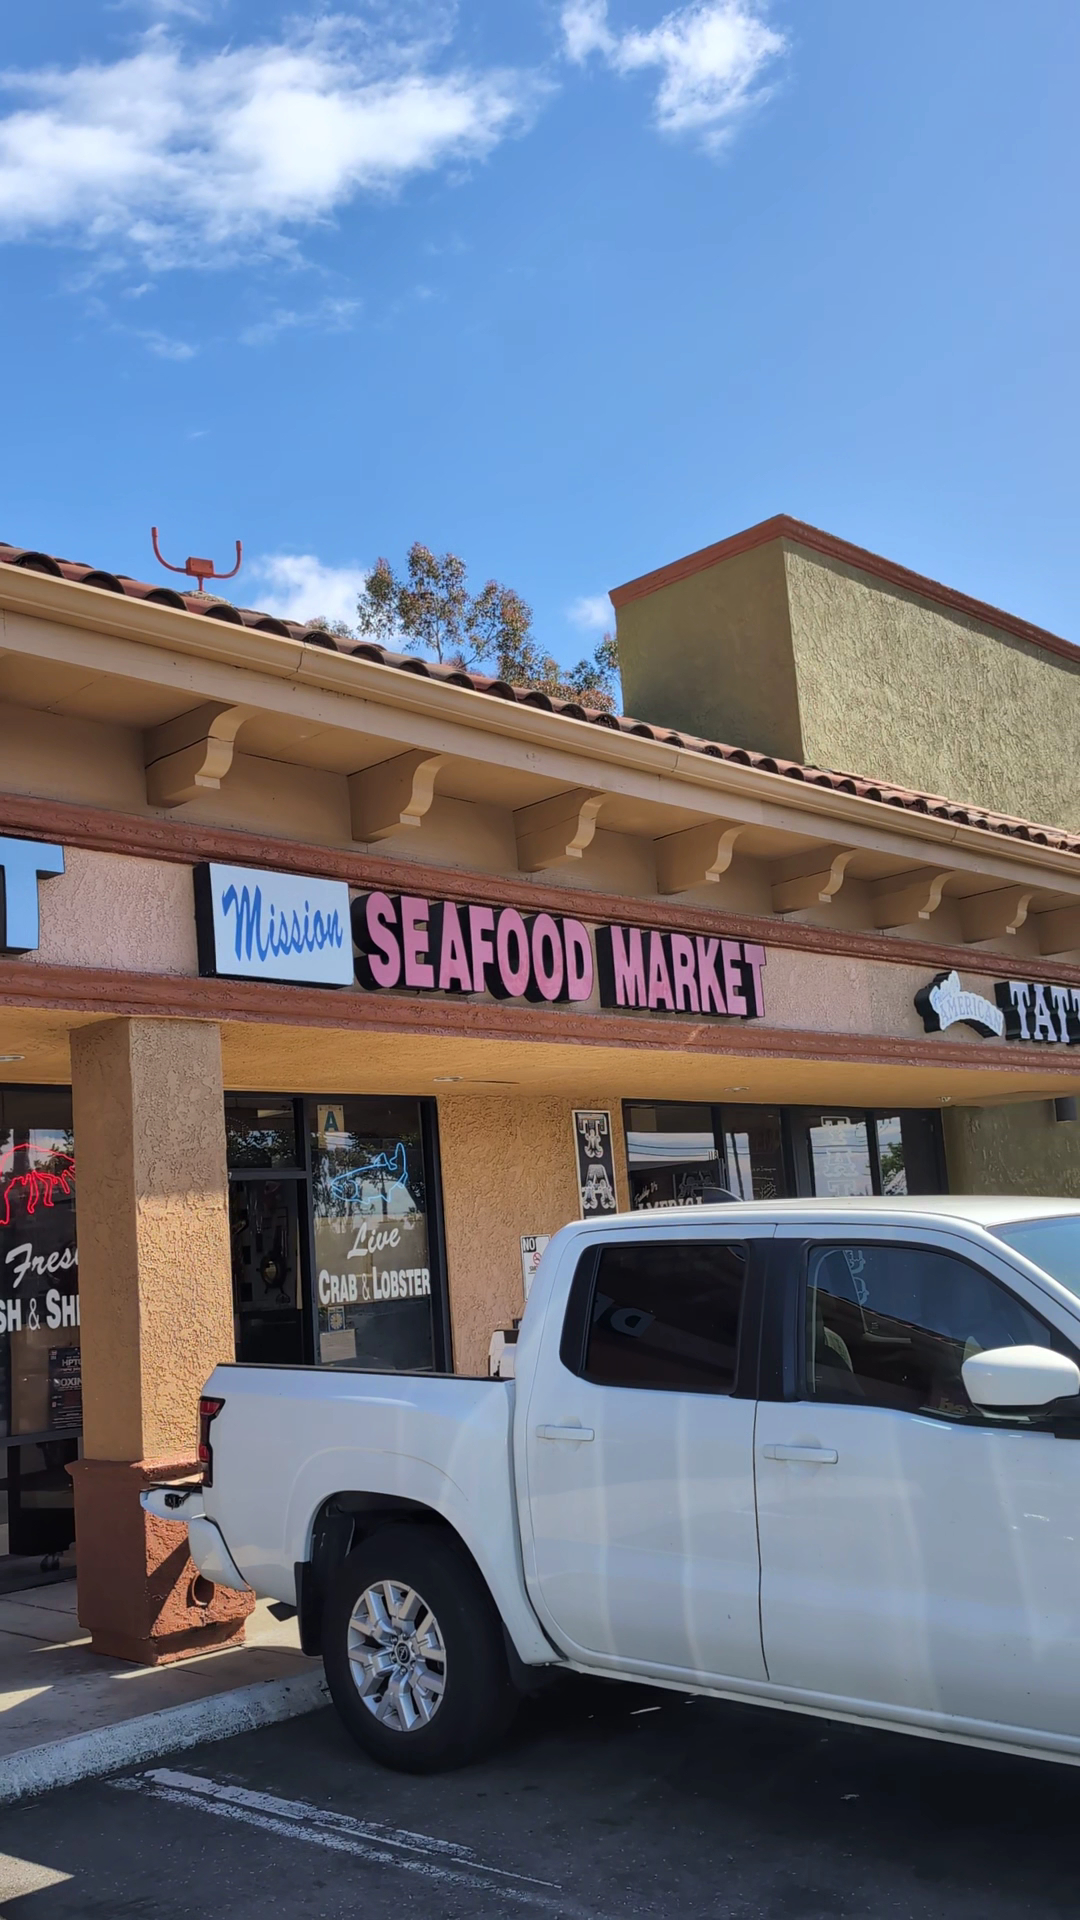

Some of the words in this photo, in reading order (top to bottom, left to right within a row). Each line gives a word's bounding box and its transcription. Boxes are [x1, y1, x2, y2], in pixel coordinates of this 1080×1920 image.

[0, 836, 65, 950] T
[222, 883, 343, 962] Mission
[366, 892, 593, 1000] SEAFOOD
[610, 925, 767, 1018] MARKET
[939, 996, 1002, 1030] AMERICAN
[324, 1111, 339, 1131] A
[577, 1113, 616, 1219] TA
[347, 1222, 400, 1259] Live
[522, 1237, 535, 1251] NO
[319, 1269, 357, 1304] CRAB
[361, 1278, 371, 1300] &
[372, 1266, 431, 1299] LOBSTER
[28, 1298, 40, 1331] &
[46, 1289, 80, 1329] SH
